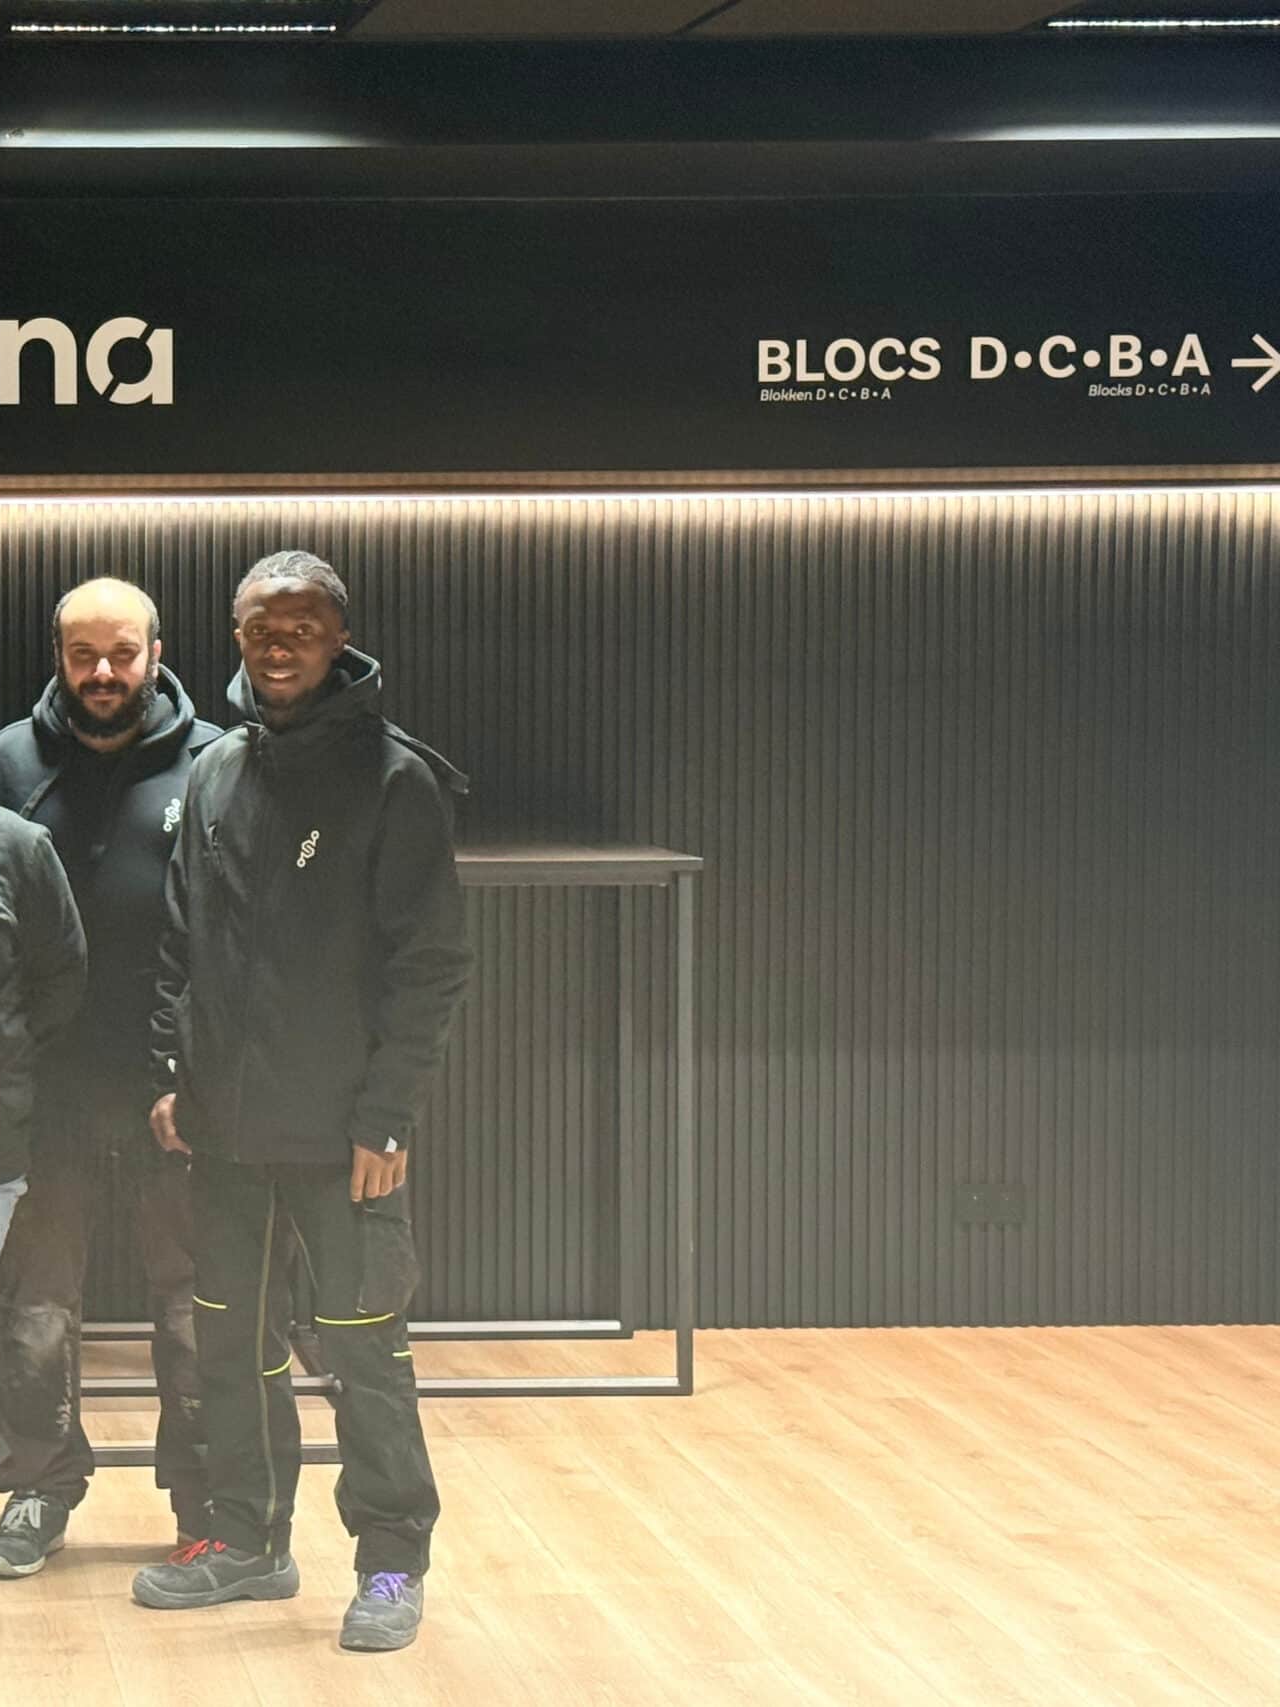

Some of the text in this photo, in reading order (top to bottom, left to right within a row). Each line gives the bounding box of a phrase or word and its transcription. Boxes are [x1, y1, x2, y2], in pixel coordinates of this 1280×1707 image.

[758, 336, 941, 382] BLOCS
[759, 388, 813, 402] Blokken
[1088, 384, 1133, 397] Blocks
